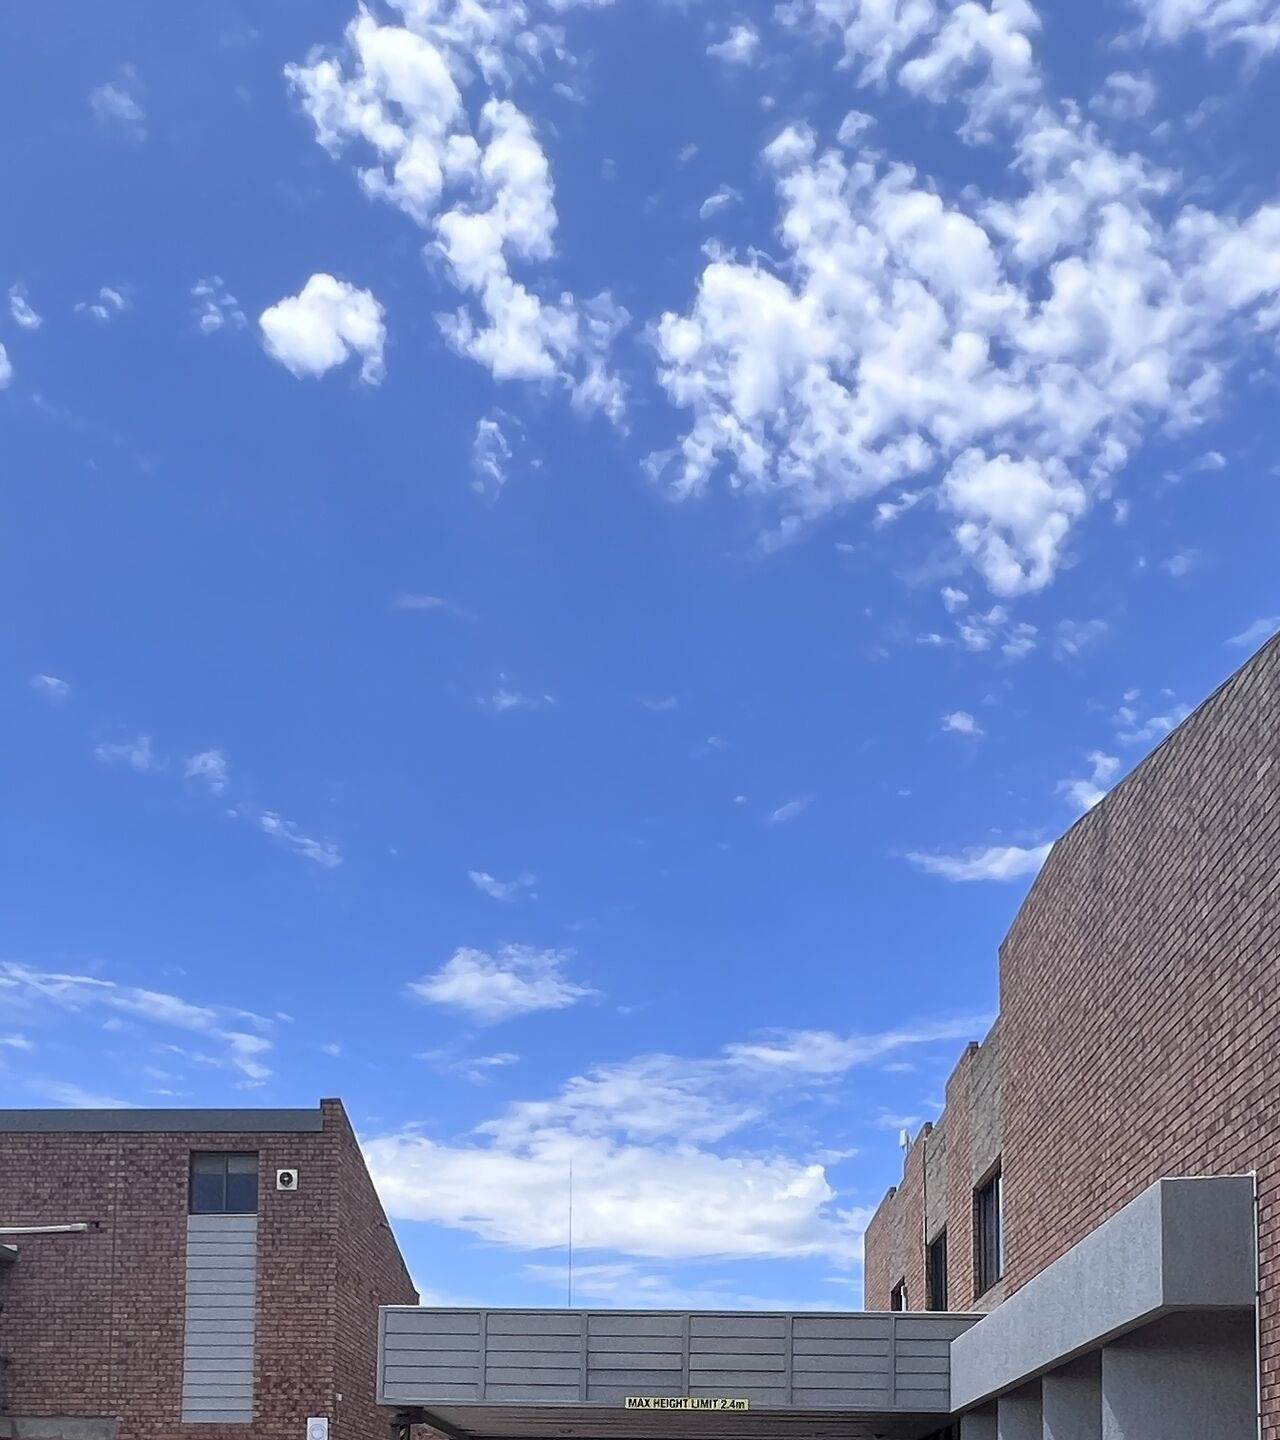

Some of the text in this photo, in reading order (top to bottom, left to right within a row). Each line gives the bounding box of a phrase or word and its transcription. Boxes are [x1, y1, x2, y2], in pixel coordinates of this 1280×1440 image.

[628, 1398, 745, 1409] MAX HEIGHT LIMIT 2.4m
